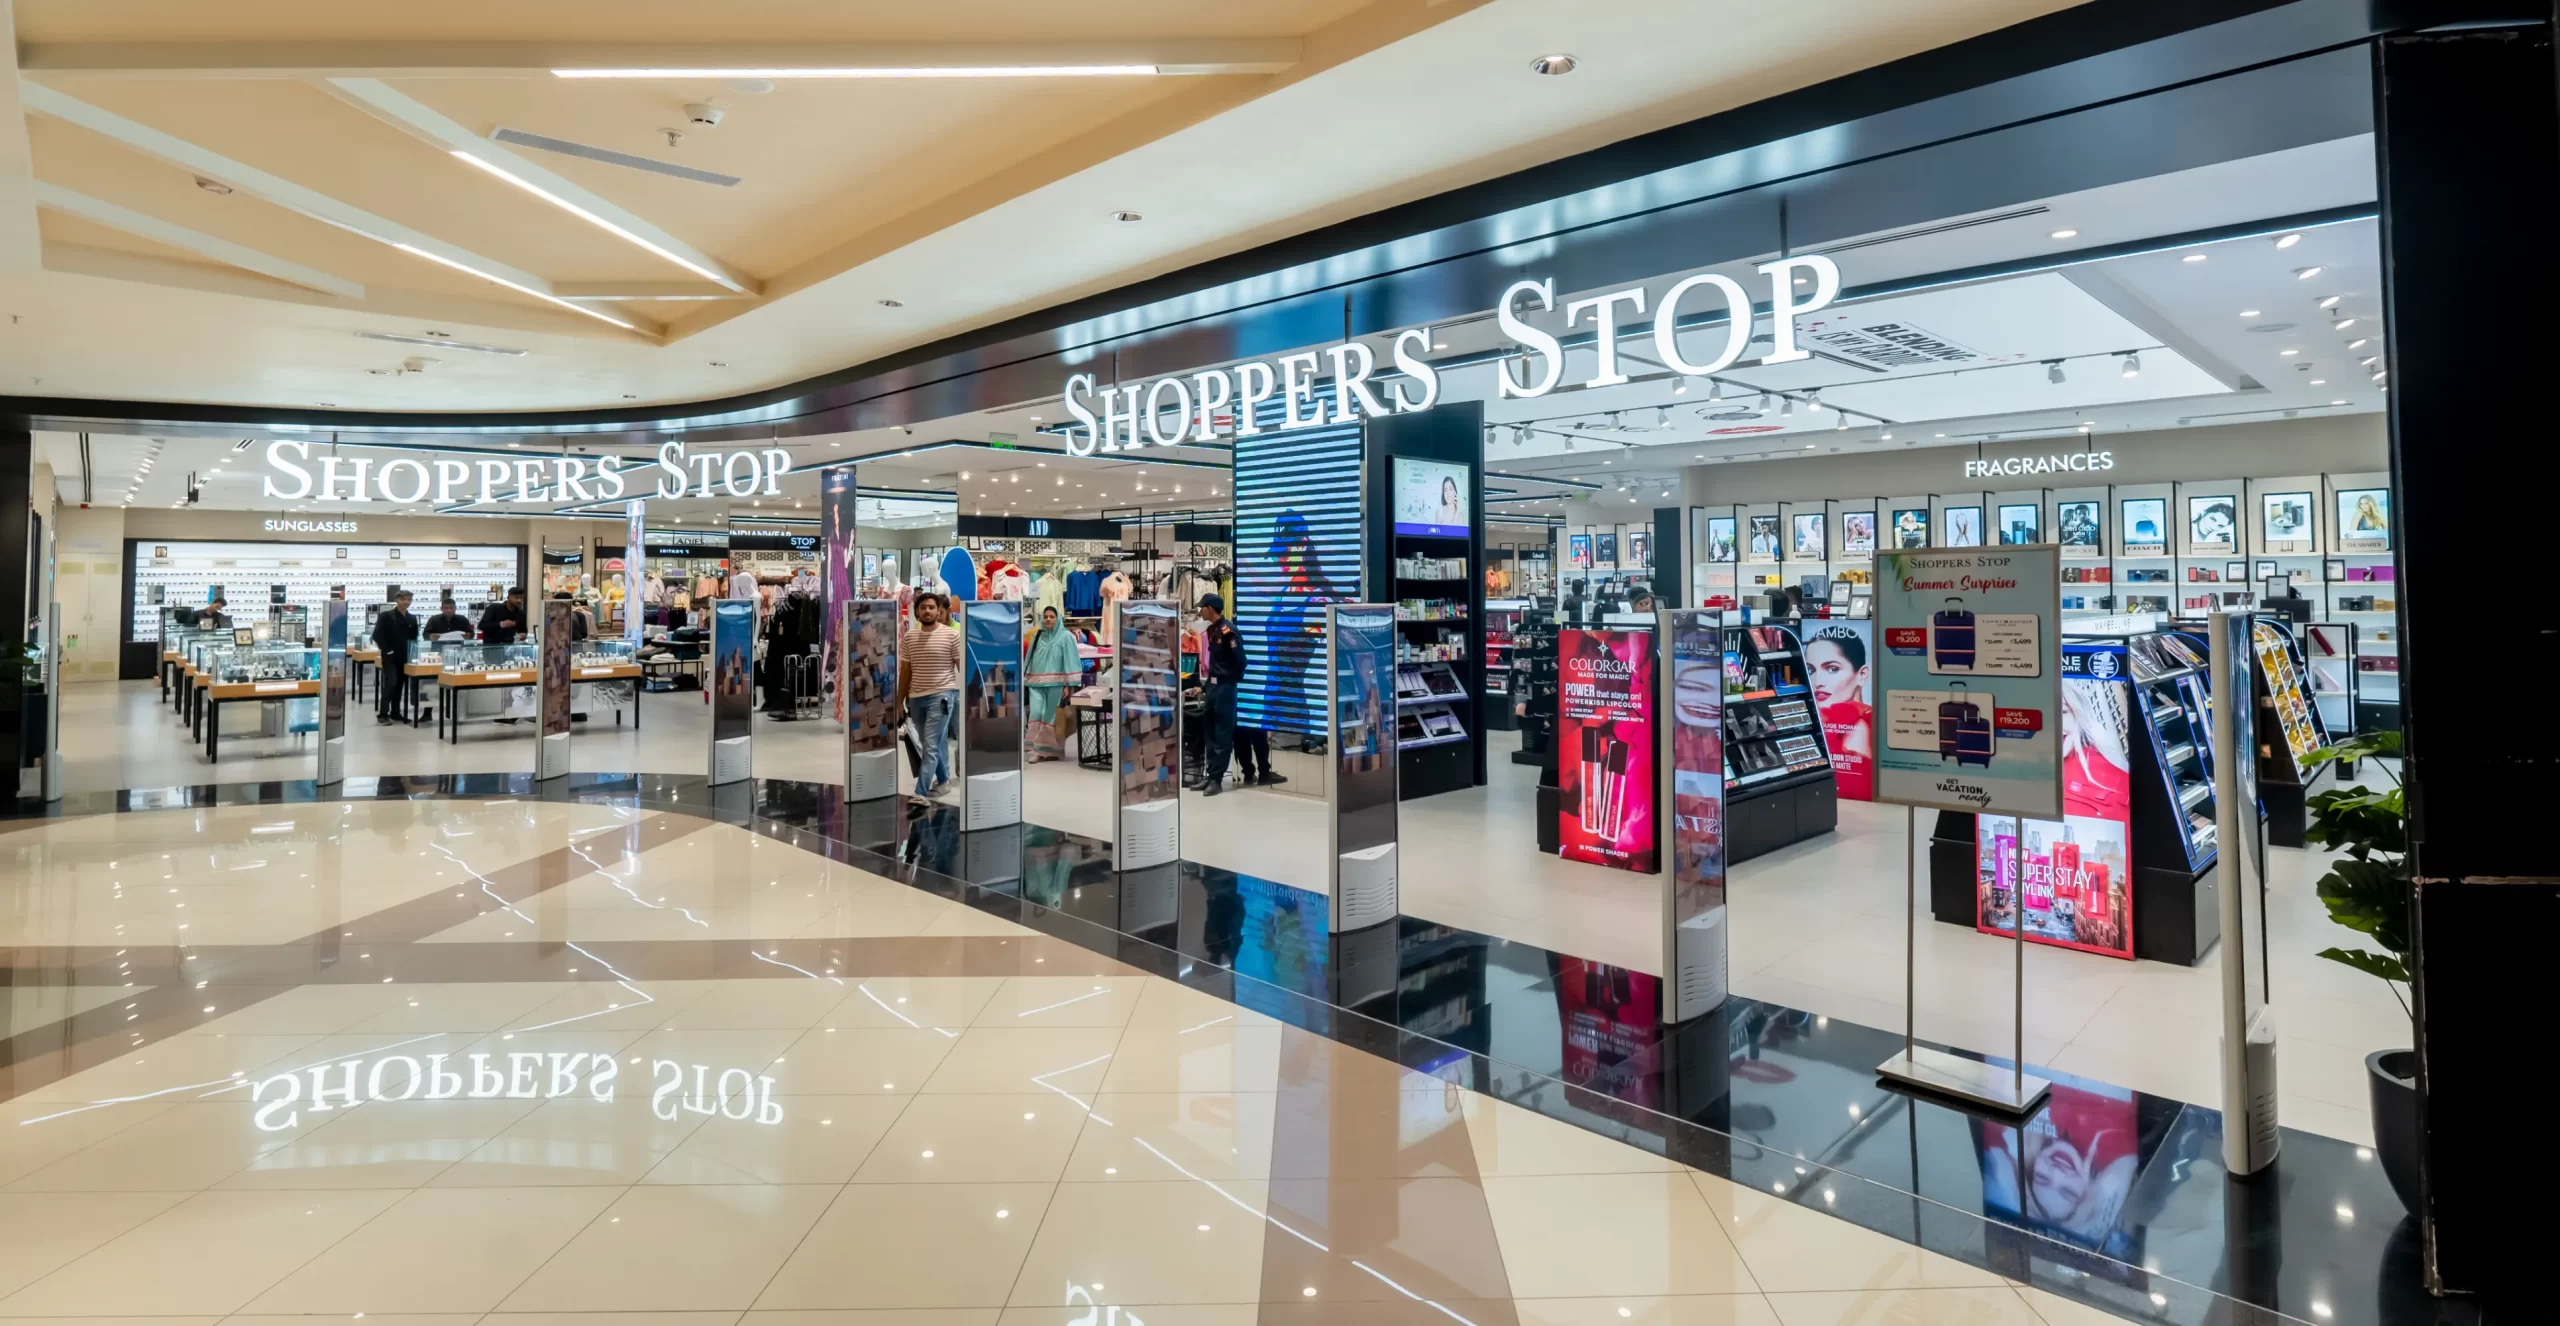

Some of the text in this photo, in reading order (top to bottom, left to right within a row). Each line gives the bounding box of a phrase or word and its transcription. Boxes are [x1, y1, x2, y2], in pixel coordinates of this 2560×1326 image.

[1861, 323, 1977, 361] BLENDING
[1064, 254, 1841, 457] SHOPPERS STOP
[263, 440, 791, 503] SHOPPERS STOP
[1965, 452, 2114, 478] FRAGRANCES
[265, 519, 357, 533] SUNGLASSES
[1029, 520, 1049, 536] AND
[790, 537, 816, 546] STOP
[1909, 556, 2011, 569] SHOPPERS STOP
[1903, 575, 2017, 594] Summer Surprises
[1569, 658, 1638, 673] COLORBAR
[1565, 683, 1595, 697] POWER
[1596, 690, 1609, 698] that
[1611, 691, 1629, 701] stays
[1565, 698, 1642, 709] POWERKISS LIPCOLOR
[1830, 753, 1862, 764] LOUR STUDIO
[1936, 782, 1983, 795] VACATION
[1958, 791, 1992, 808] ready
[1585, 845, 1605, 854] POWER
[1605, 847, 1629, 858] SHADES
[2008, 847, 2029, 861] NW
